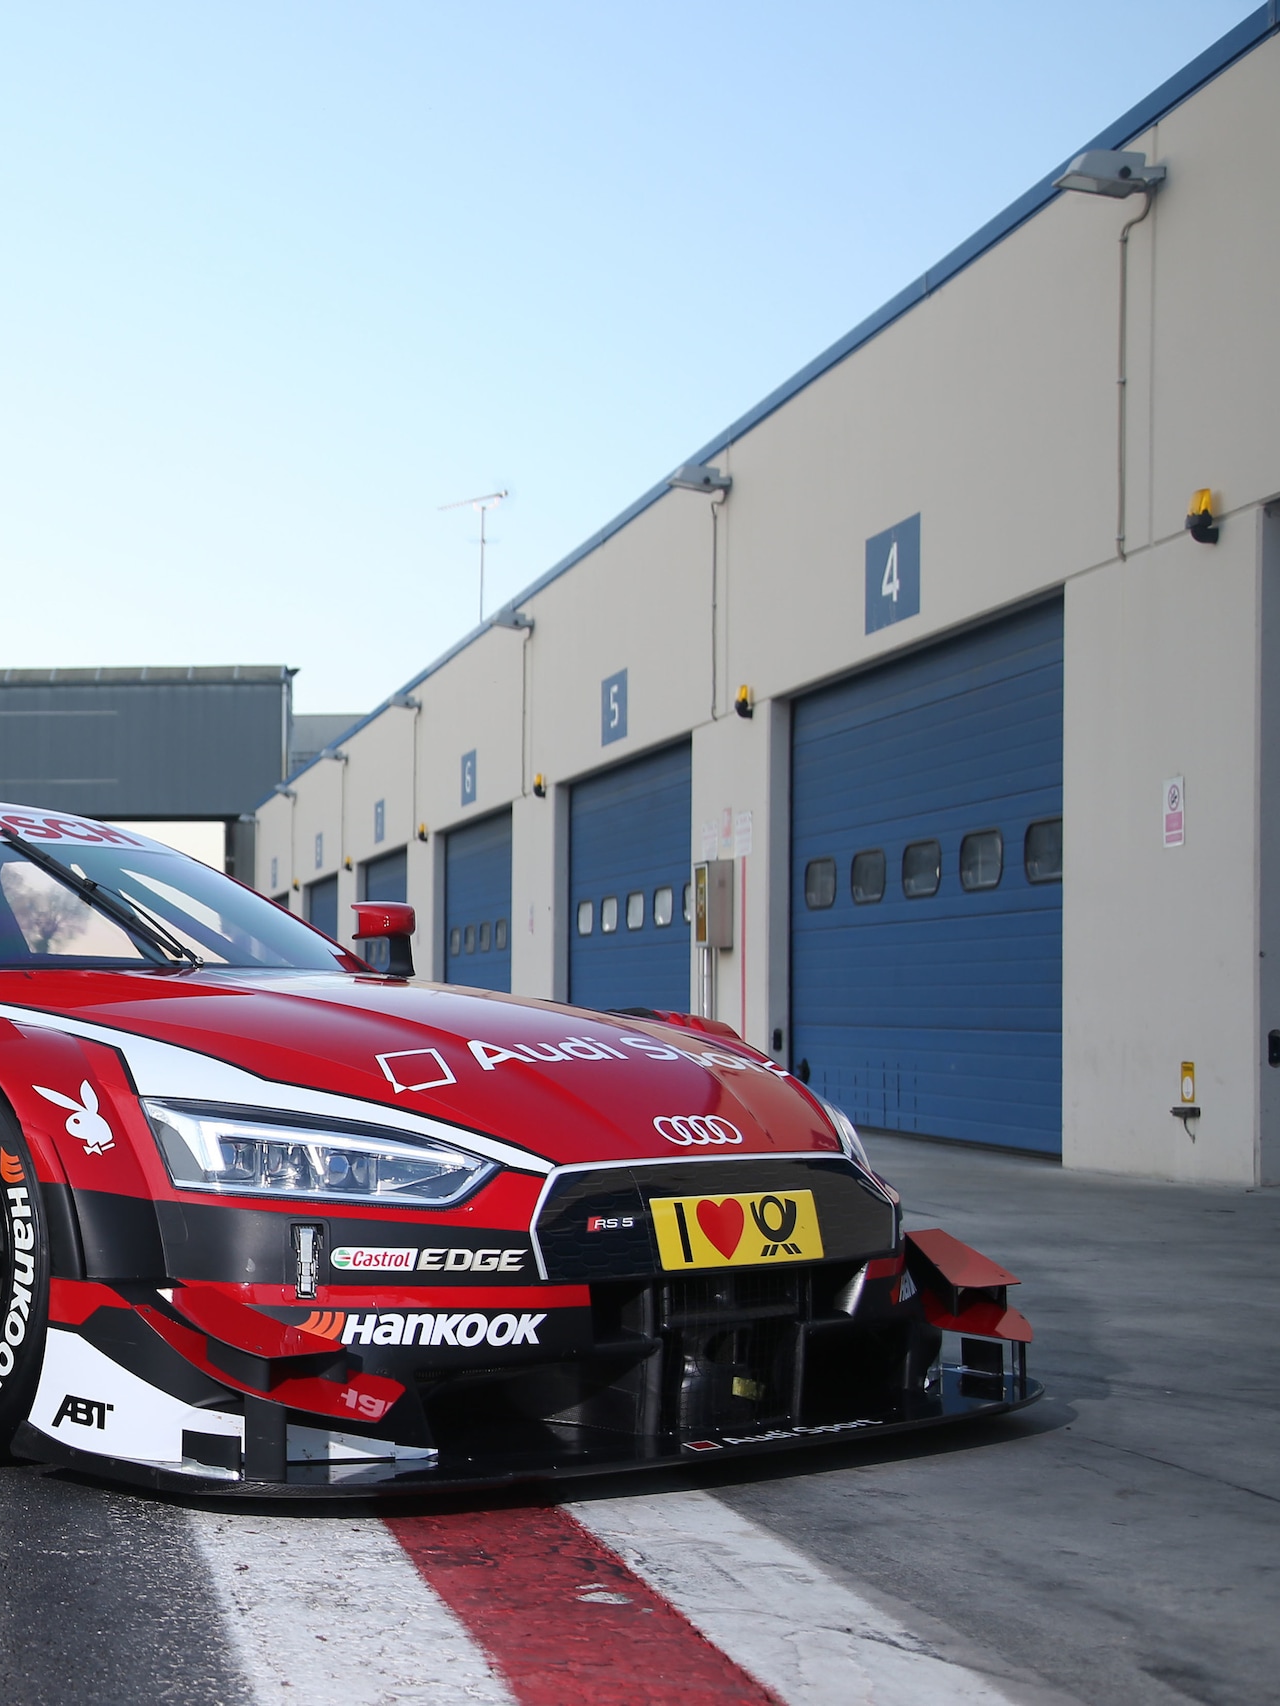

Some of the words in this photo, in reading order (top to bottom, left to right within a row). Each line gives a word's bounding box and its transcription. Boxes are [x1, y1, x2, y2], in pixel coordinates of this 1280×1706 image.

[881, 541, 900, 602] 4
[610, 684, 619, 728] 5
[466, 1036, 630, 1071] Audi
[594, 1217, 618, 1230] RS
[673, 1202, 694, 1263] I
[352, 1249, 411, 1269] Castrol
[416, 1247, 529, 1272] EDGE
[51, 1394, 115, 1431] ABT
